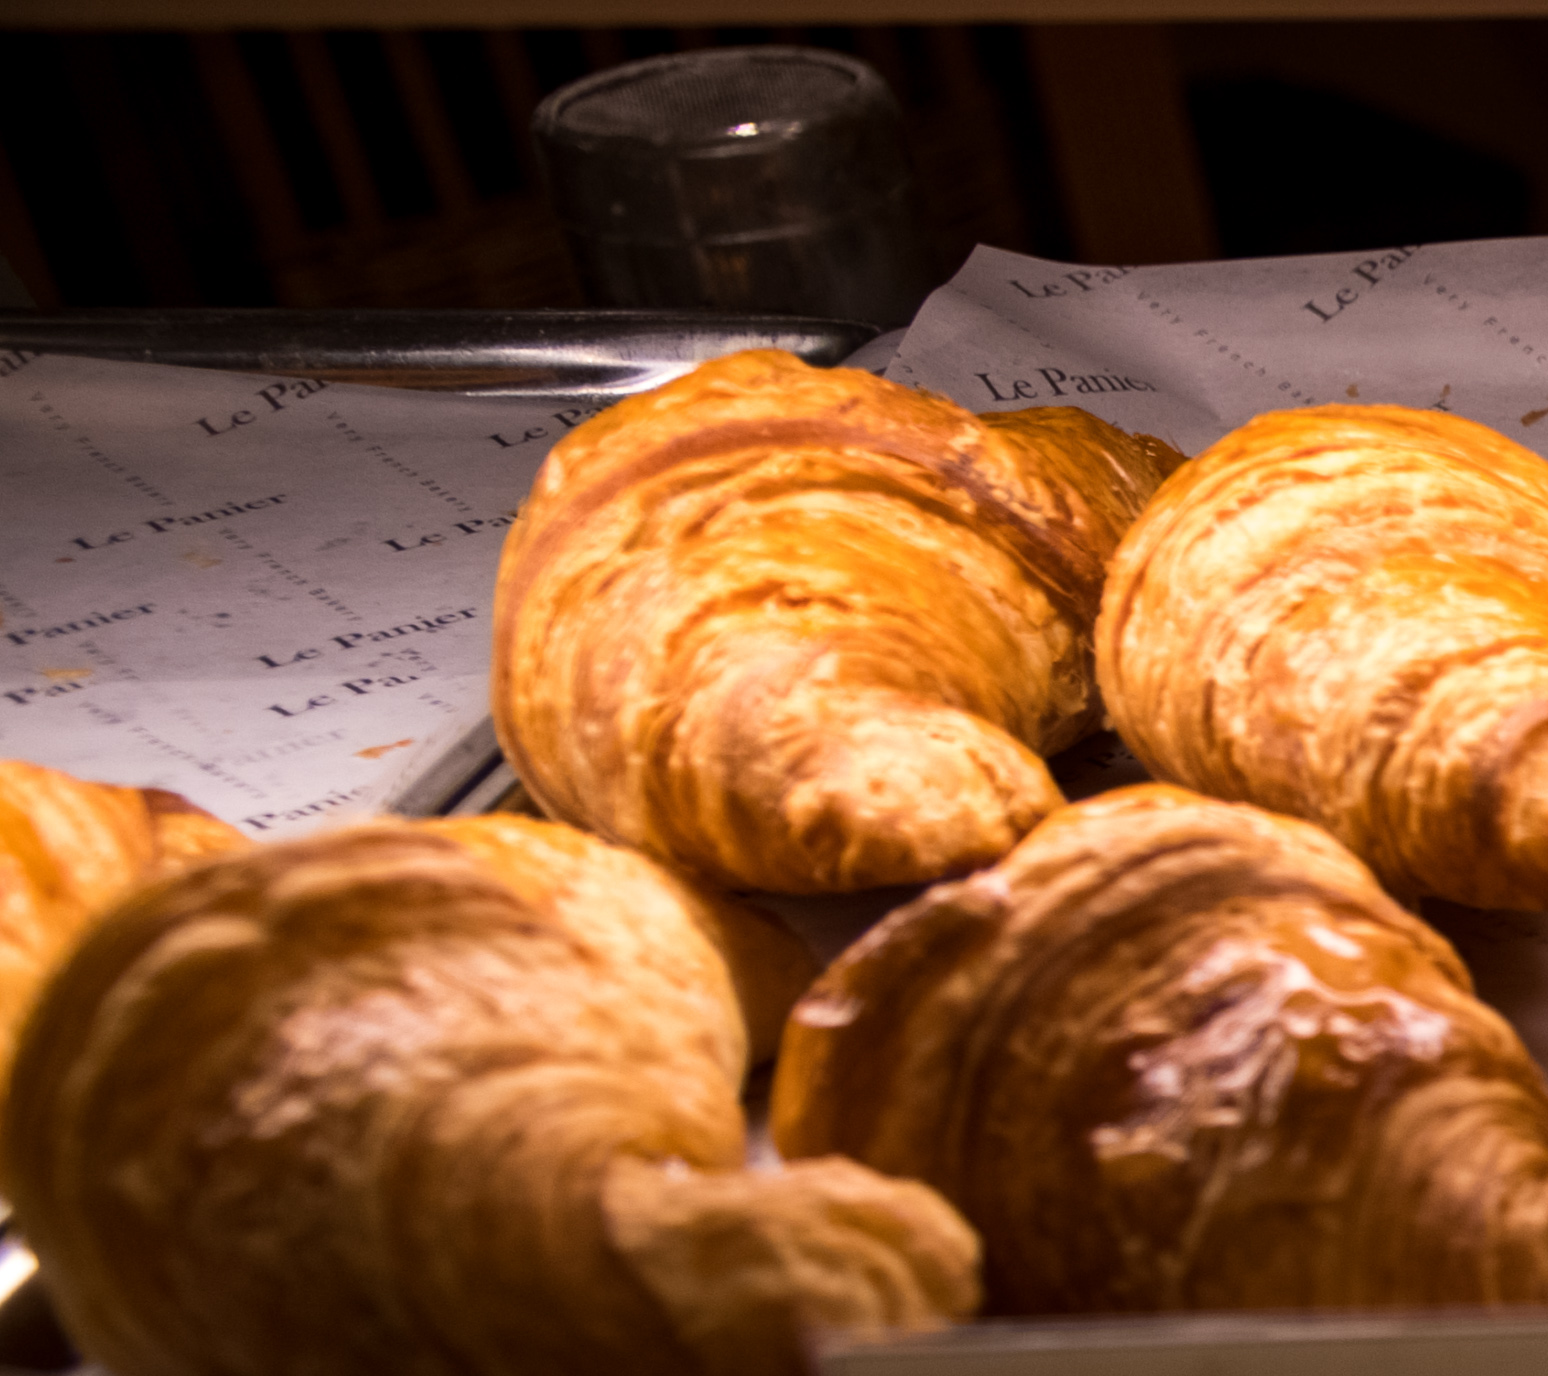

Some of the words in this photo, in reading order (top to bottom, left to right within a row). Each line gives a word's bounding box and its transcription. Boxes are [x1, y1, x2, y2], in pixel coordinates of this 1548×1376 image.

[1008, 276, 1067, 300] Le
[1303, 283, 1360, 325] Le
[1423, 270, 1470, 313] Very
[1138, 289, 1183, 326] Very
[973, 370, 1039, 403] Le
[192, 408, 257, 438] Le
[489, 424, 549, 449] Le
[69, 531, 135, 550] Le
[140, 494, 288, 535] Panier
[381, 533, 448, 552] Le
[453, 515, 522, 537] Pa
[3, 603, 157, 646] Panier
[255, 648, 325, 669] Le
[328, 606, 478, 651] Panier
[267, 694, 333, 717] Le
